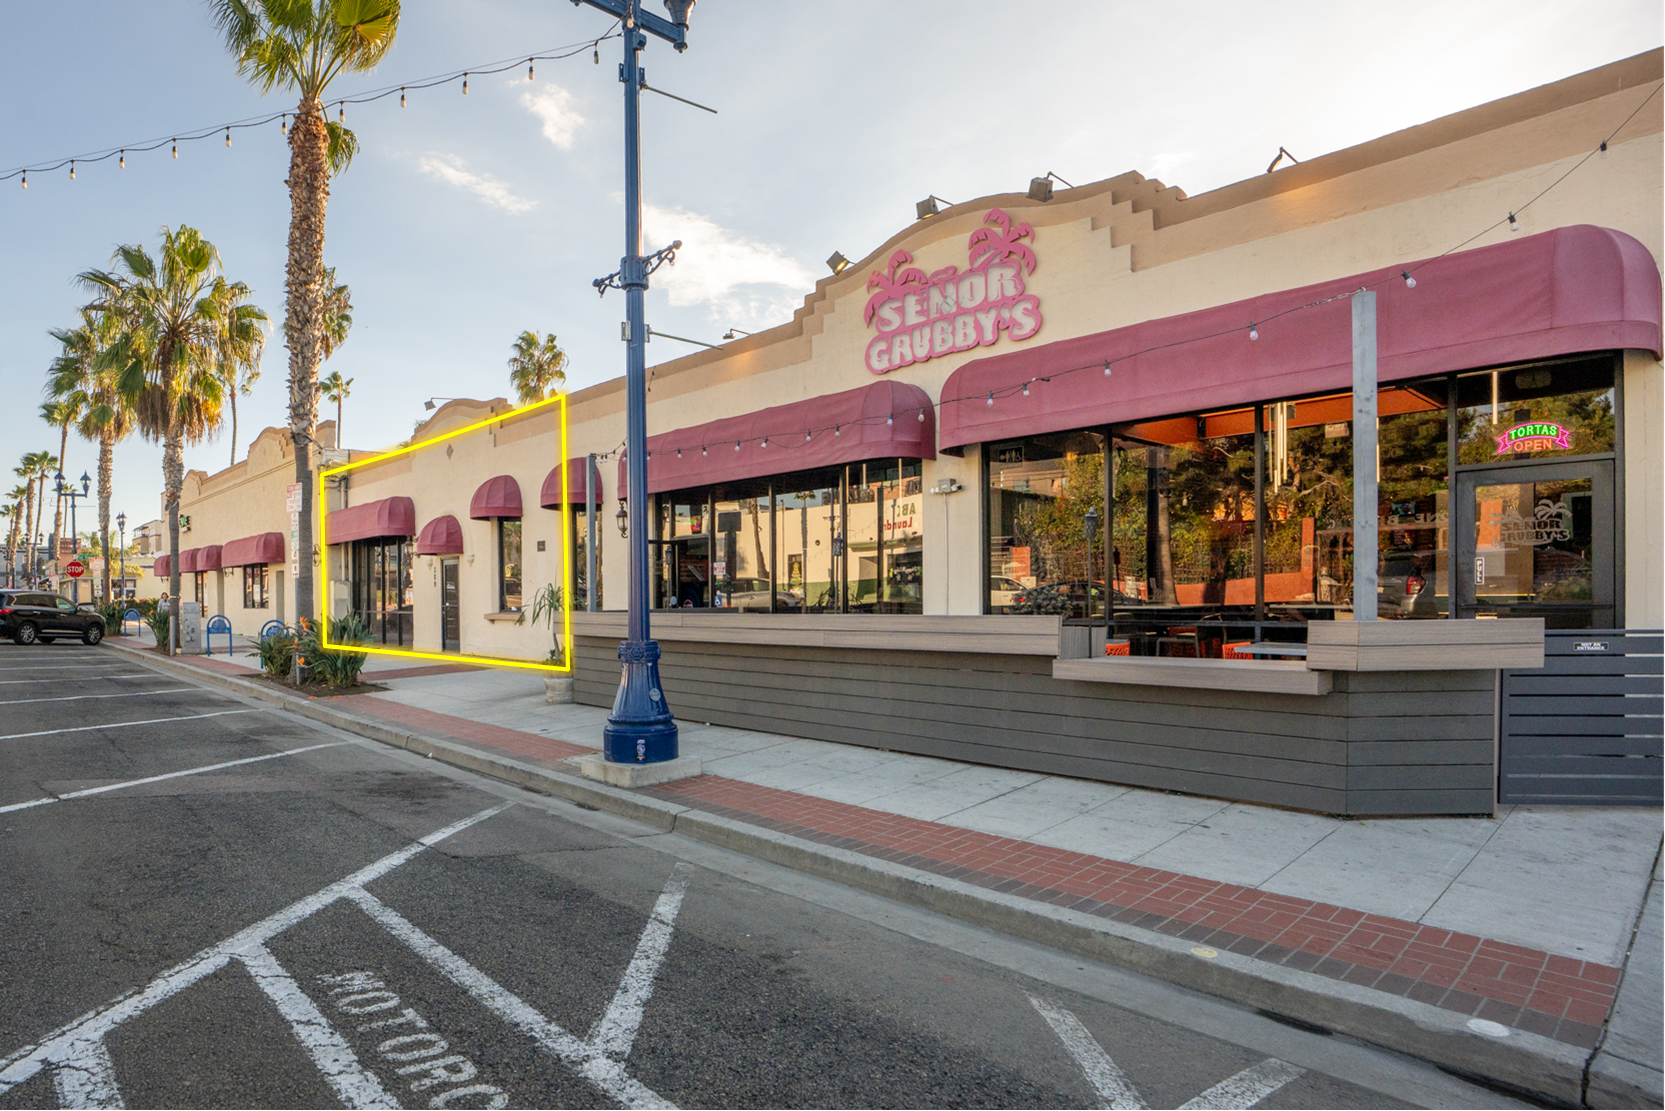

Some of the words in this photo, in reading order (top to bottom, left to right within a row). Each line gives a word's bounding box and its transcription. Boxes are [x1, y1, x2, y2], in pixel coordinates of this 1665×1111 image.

[876, 260, 1023, 332] SEÑOR
[867, 296, 1040, 373] GRUBBY'S
[1509, 424, 1558, 440] TORTAS
[1513, 439, 1553, 452] OPEN
[67, 565, 84, 574] STOP
